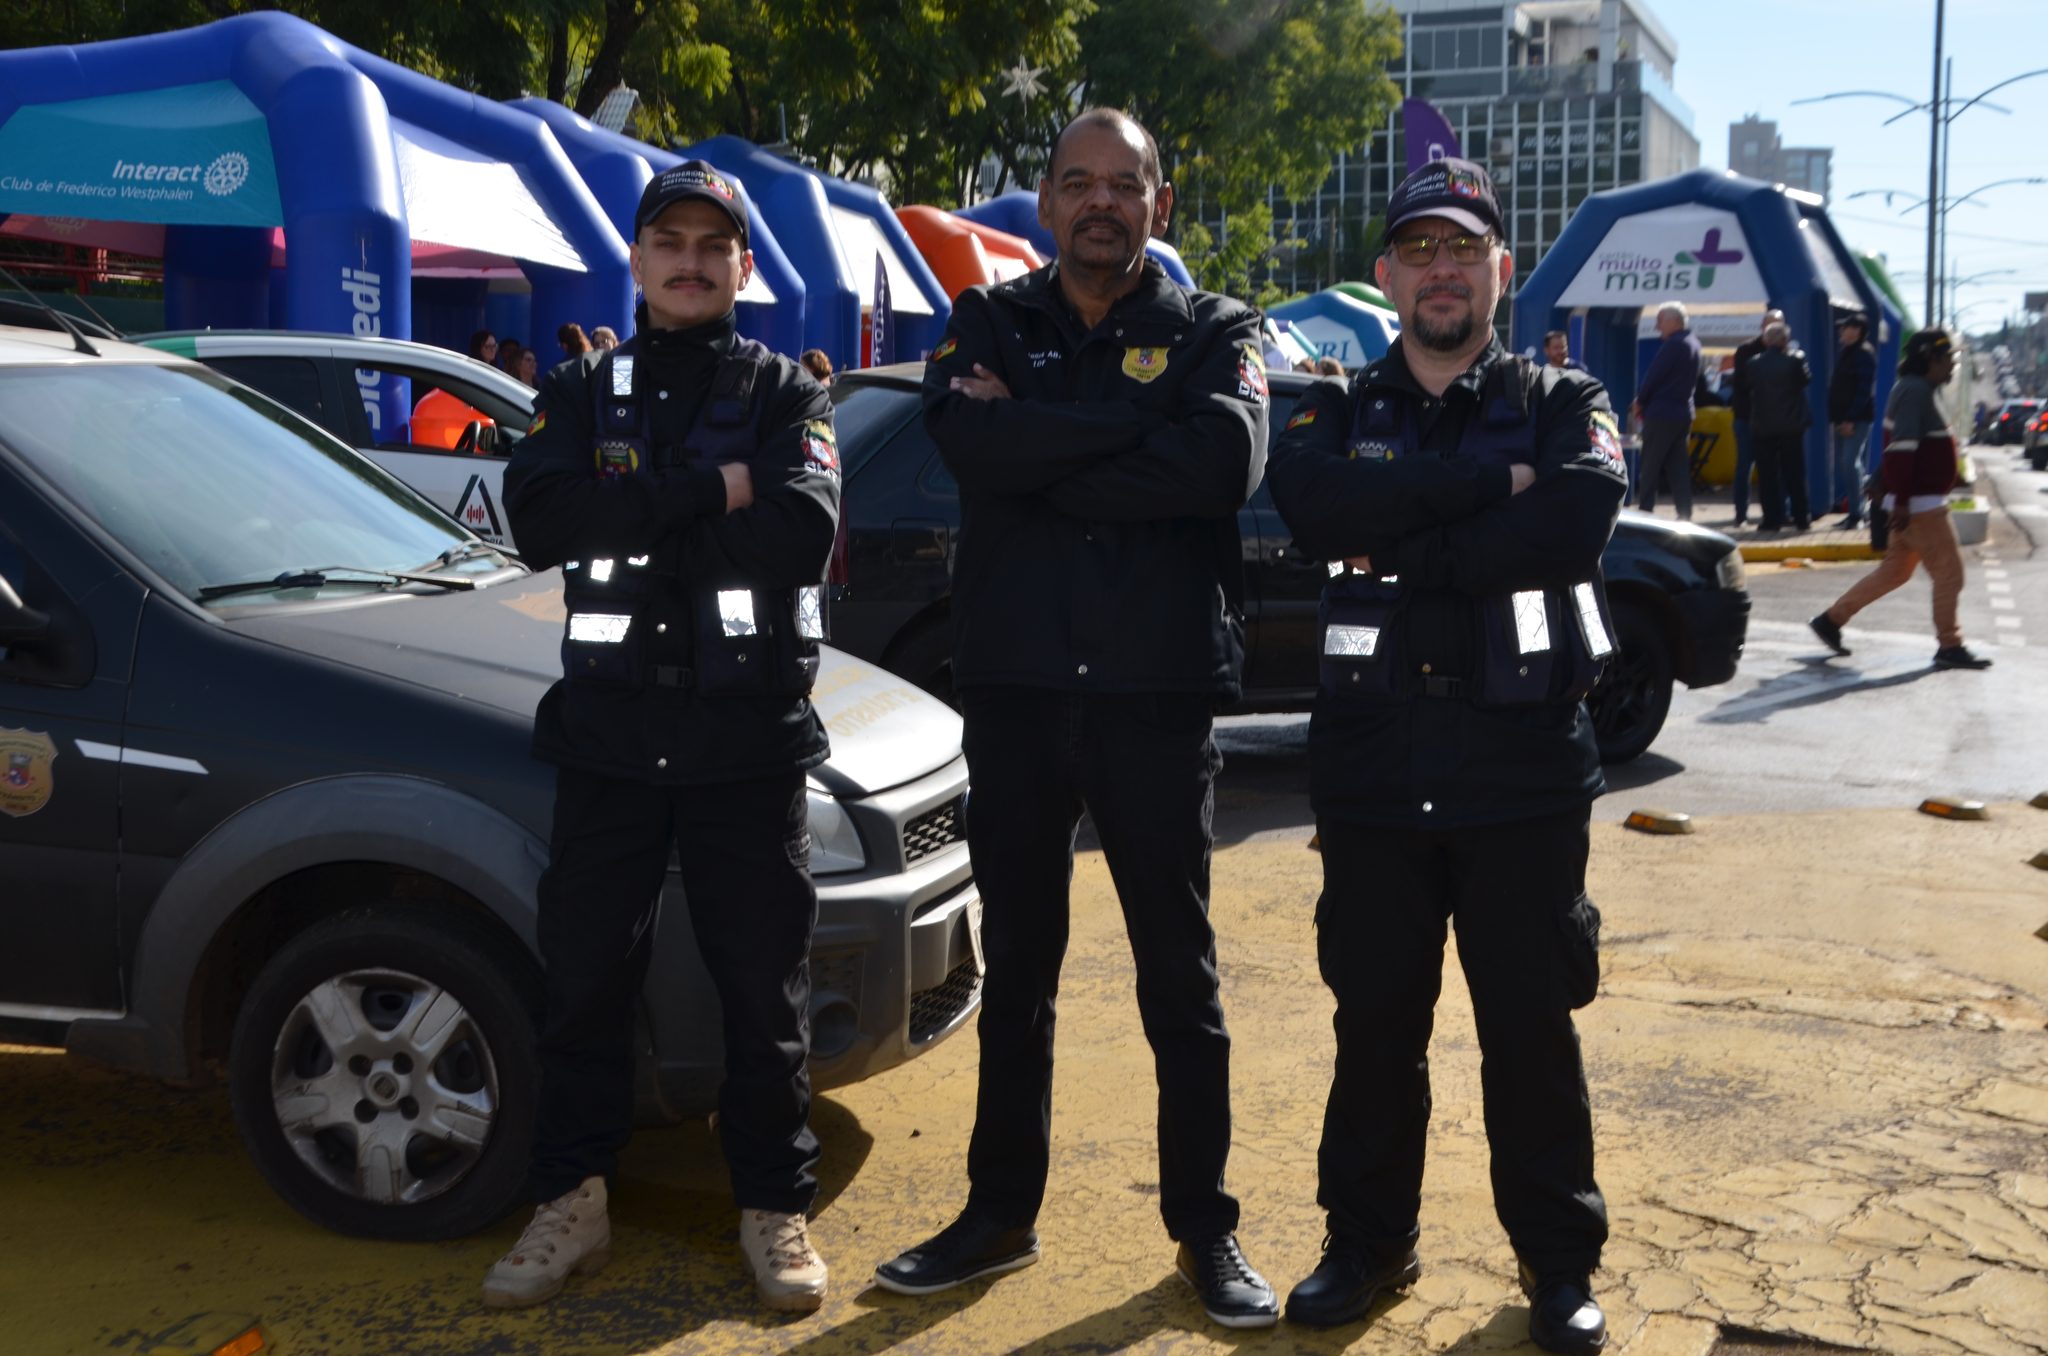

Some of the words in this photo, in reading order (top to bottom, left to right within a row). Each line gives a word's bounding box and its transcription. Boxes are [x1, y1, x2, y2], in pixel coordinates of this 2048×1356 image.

[112, 159, 201, 182] Interact
[0, 176, 33, 191] Club
[36, 179, 53, 193] de
[56, 181, 117, 198] Frederico
[120, 185, 194, 201] Westphalen
[1599, 255, 1662, 271] muito
[1604, 264, 1691, 291] mais
